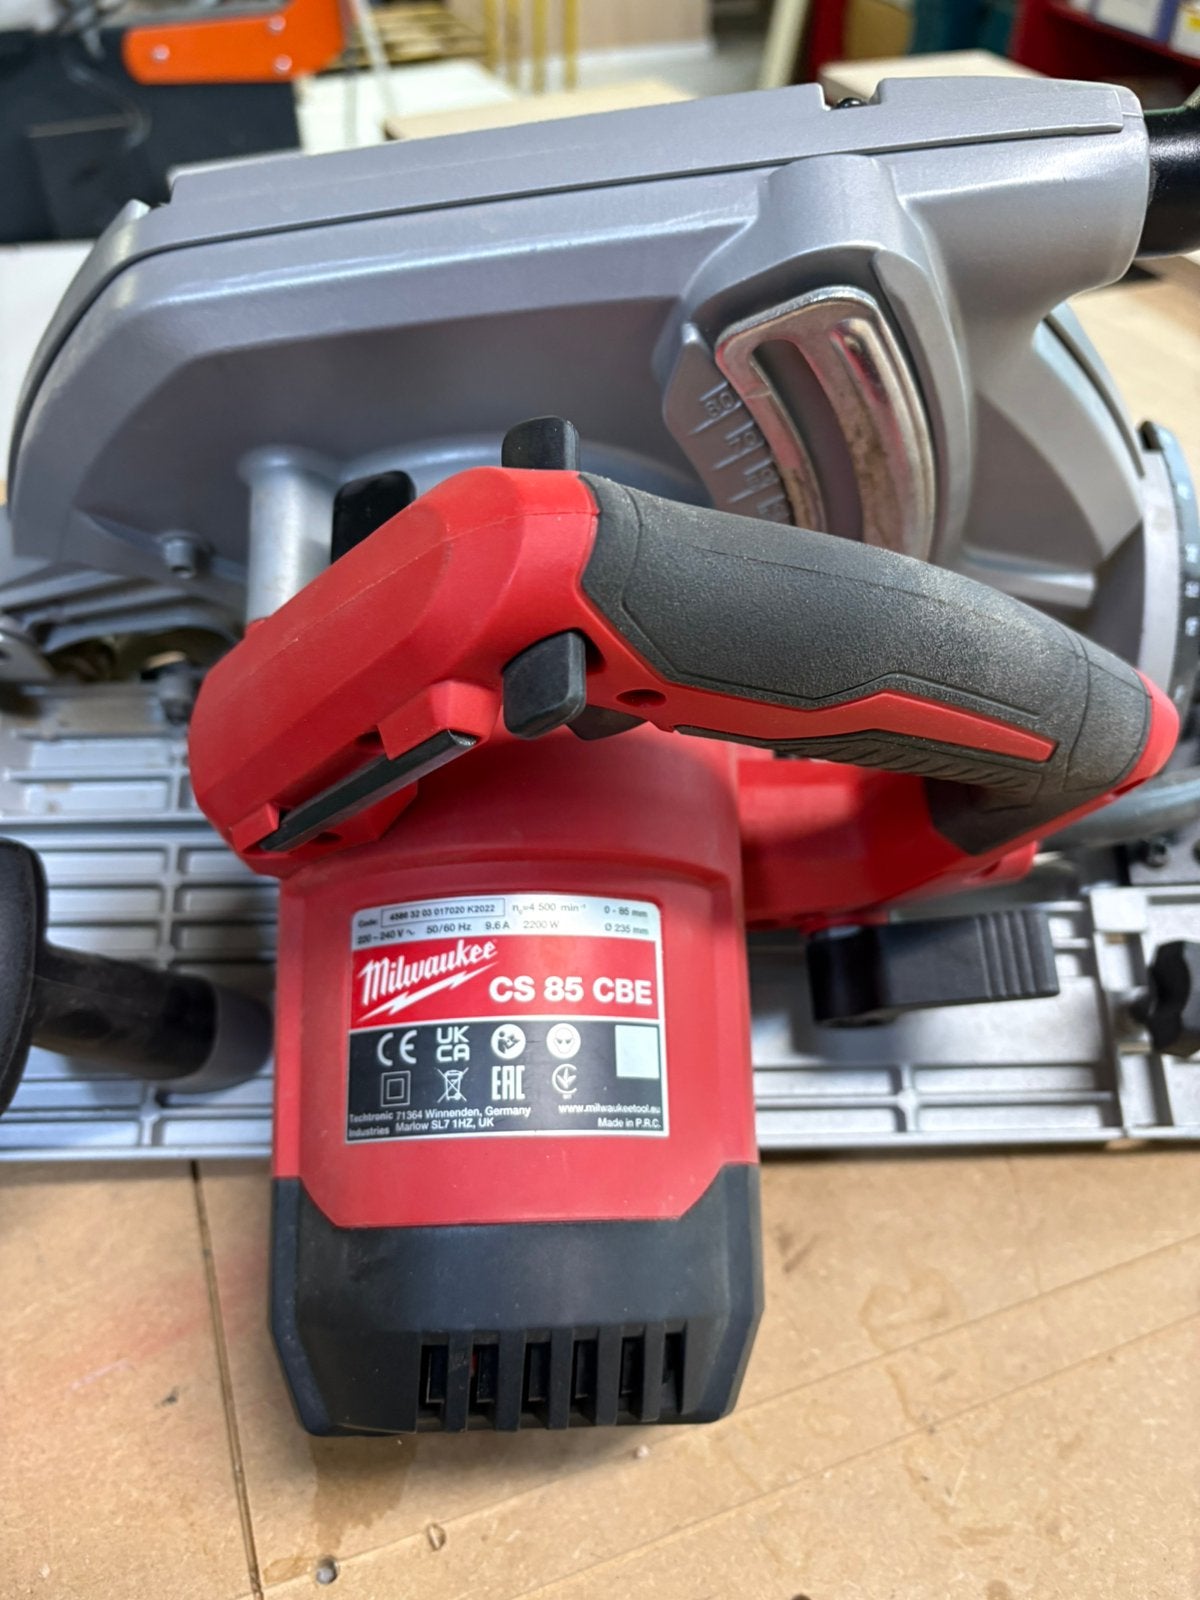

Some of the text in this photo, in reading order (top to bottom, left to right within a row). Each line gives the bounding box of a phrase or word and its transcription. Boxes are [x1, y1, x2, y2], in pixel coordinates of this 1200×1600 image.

[434, 907, 466, 916] 017020
[467, 904, 496, 913] K2022
[604, 905, 610, 914] 0
[632, 909, 648, 918] mm
[396, 928, 404, 938] V
[426, 924, 456, 934] 50/60
[458, 922, 472, 932] Hz
[485, 922, 500, 930] 9.6
[502, 920, 510, 929] A
[523, 920, 548, 929] 2200
[549, 920, 560, 928] W
[614, 924, 630, 934] 235
[633, 926, 649, 935] mm
[357, 938, 498, 1006] Milwaukee
[489, 975, 653, 1006] CS 85 CBE
[436, 1026, 470, 1044] UK
[376, 1029, 418, 1067] CE
[436, 1044, 470, 1062] CA
[492, 1065, 526, 1100] EAC
[350, 1106, 532, 1122] Techtronic 71364 Winnenden, Germany
[558, 1103, 661, 1114] www.milwaukeetool.eu
[348, 1117, 494, 1137] Industries Marlow SL7 1HZ, UK
[598, 1117, 662, 1128] Made in P.R.C.
